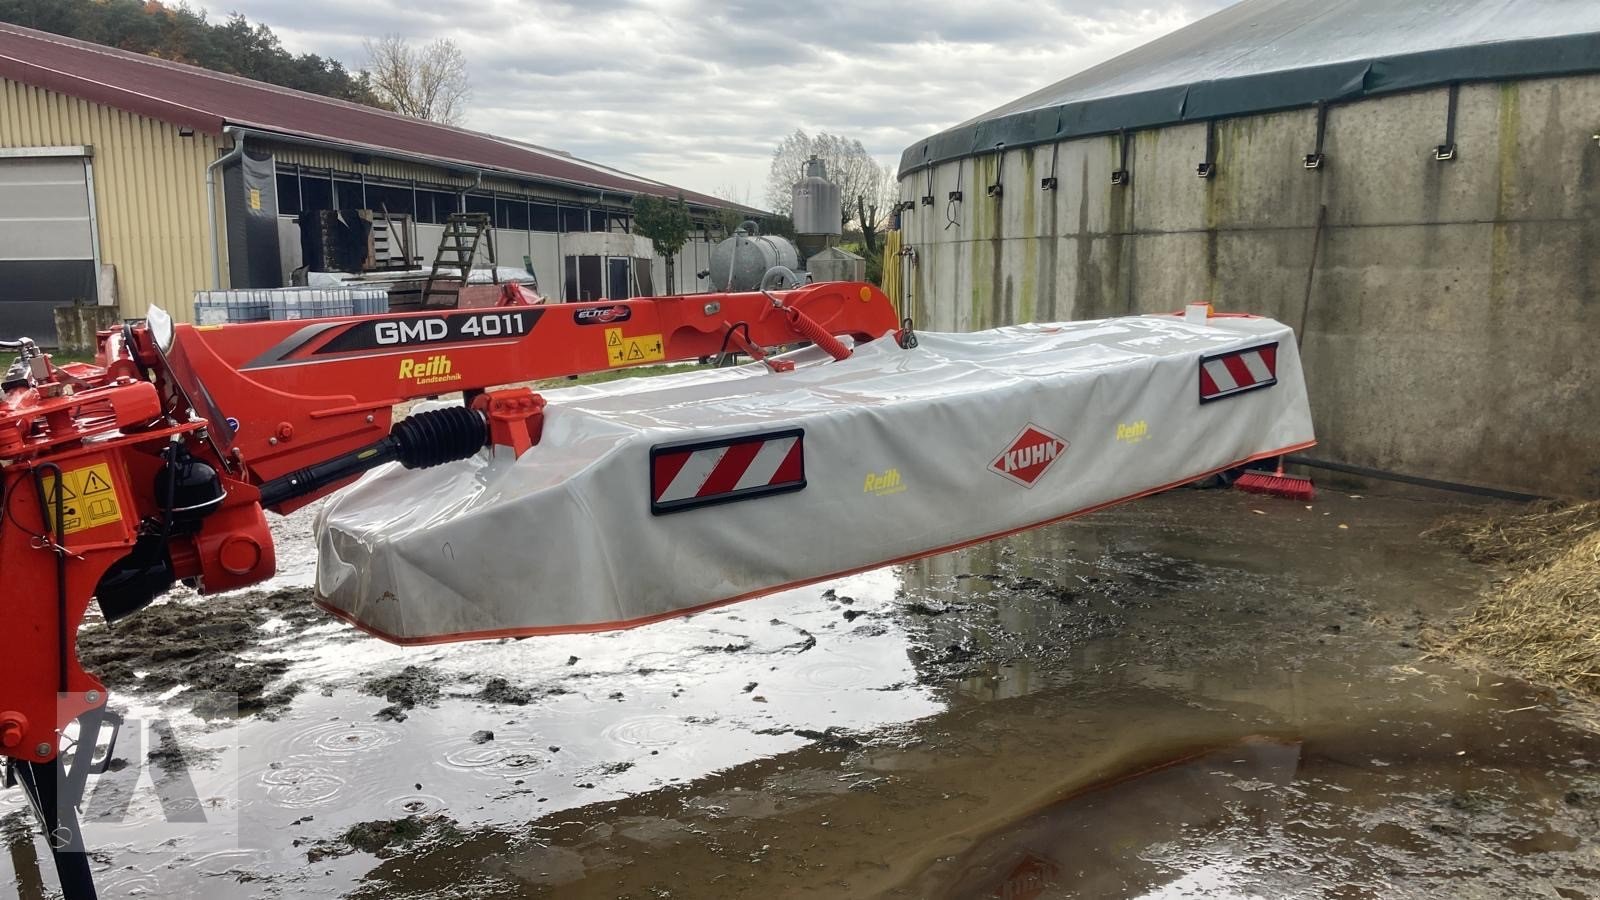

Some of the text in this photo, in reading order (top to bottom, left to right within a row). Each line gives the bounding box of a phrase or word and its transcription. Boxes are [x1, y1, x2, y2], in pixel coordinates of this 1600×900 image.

[578, 309, 611, 319] ELITE
[375, 313, 524, 345] GMD 4011
[399, 354, 451, 380] Reith
[416, 373, 462, 385] Landtechnik
[1004, 439, 1059, 473] KUHN
[864, 469, 900, 493] Reith
